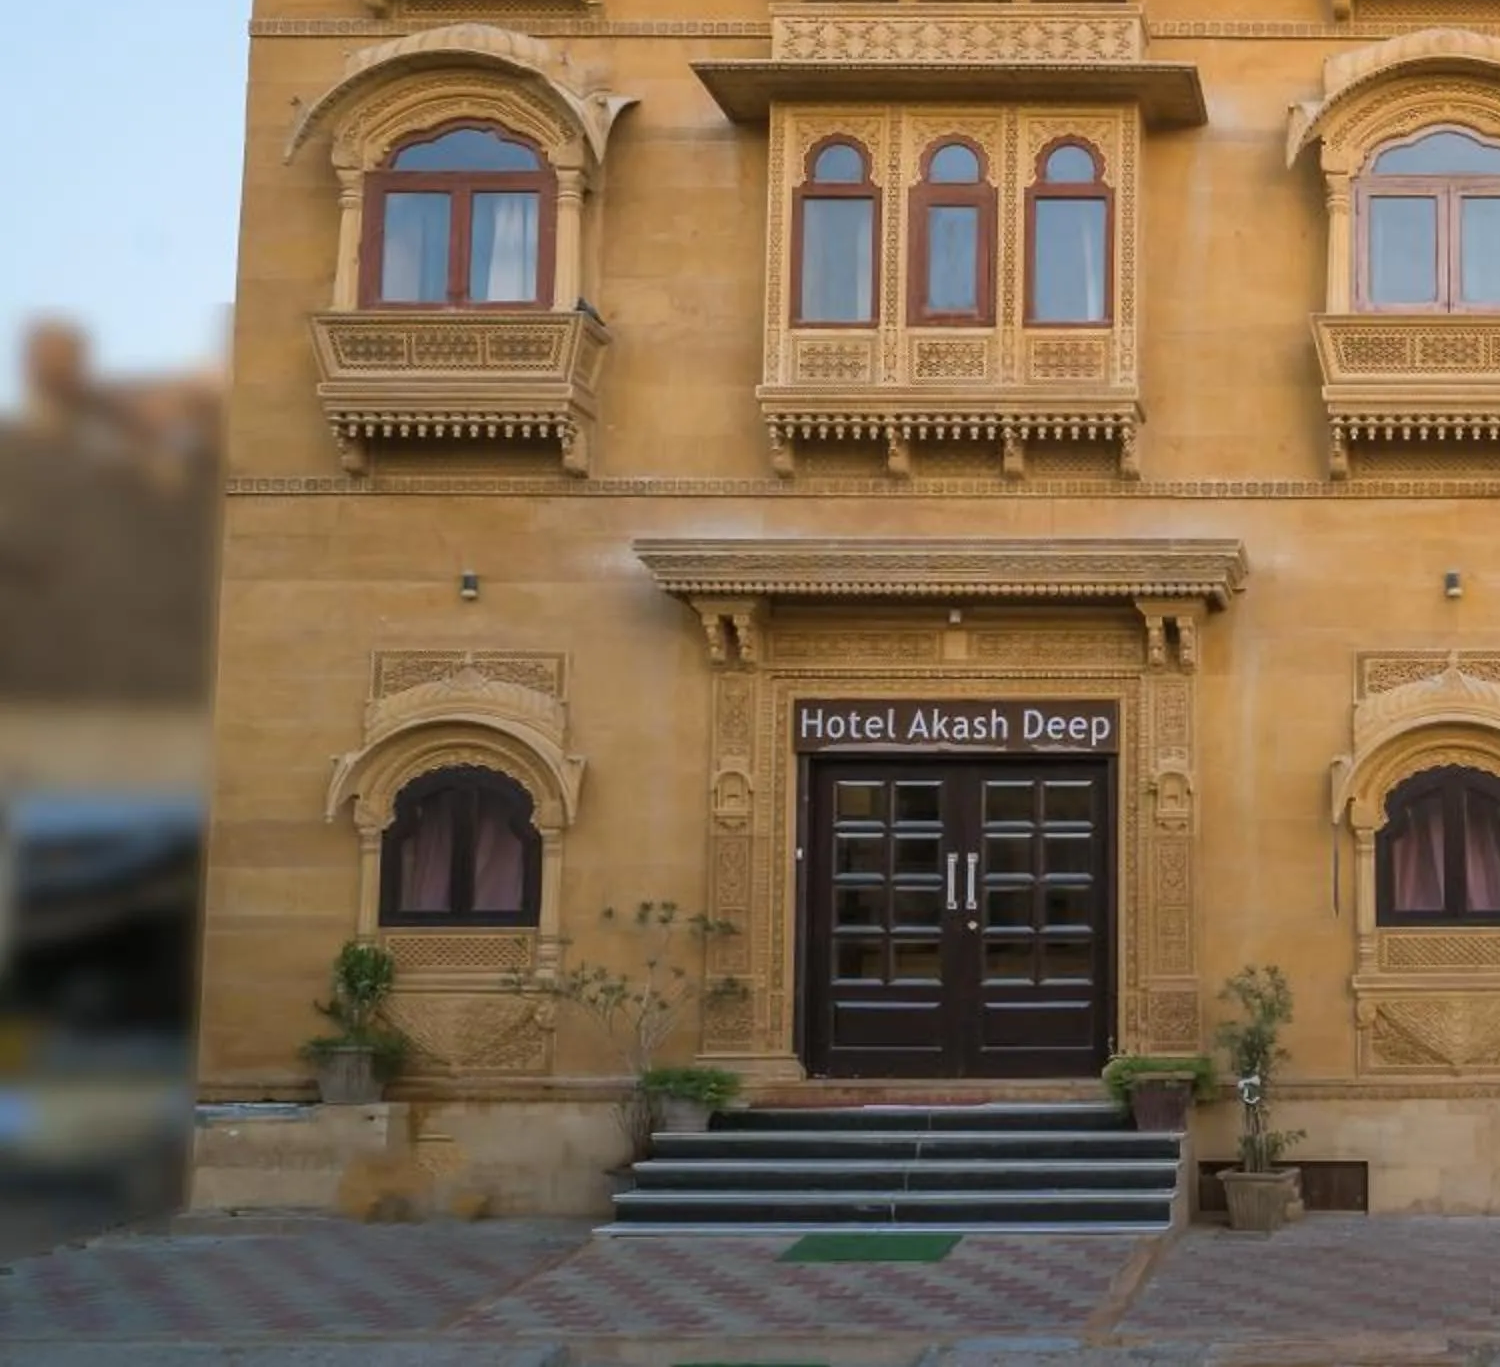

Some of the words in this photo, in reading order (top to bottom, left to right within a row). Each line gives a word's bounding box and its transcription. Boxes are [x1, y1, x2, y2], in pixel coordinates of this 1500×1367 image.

[800, 708, 896, 739] Hotel
[907, 708, 1008, 740] Akash
[1022, 709, 1110, 746] Deep
